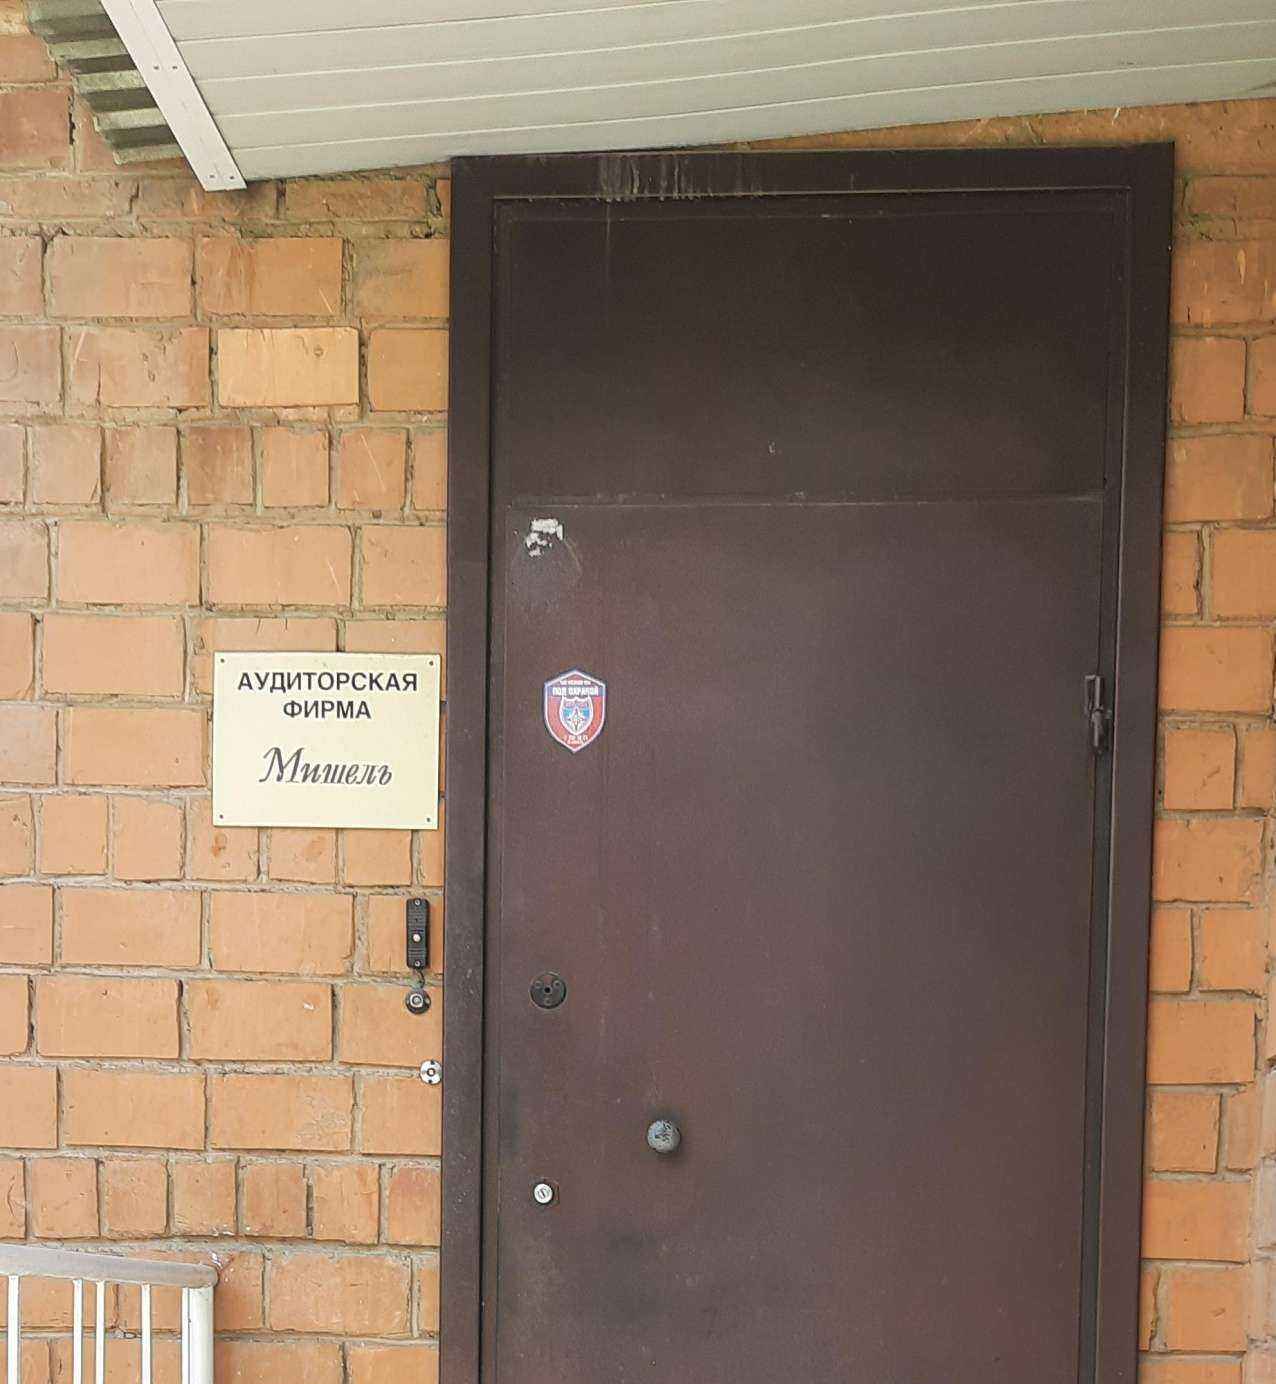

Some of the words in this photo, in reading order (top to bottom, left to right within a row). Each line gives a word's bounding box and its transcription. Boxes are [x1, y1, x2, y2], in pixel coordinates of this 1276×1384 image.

[237, 671, 418, 694] АУДИТОРСКАЯ
[282, 700, 372, 720] ФИРМА
[258, 746, 393, 786] Мишель
